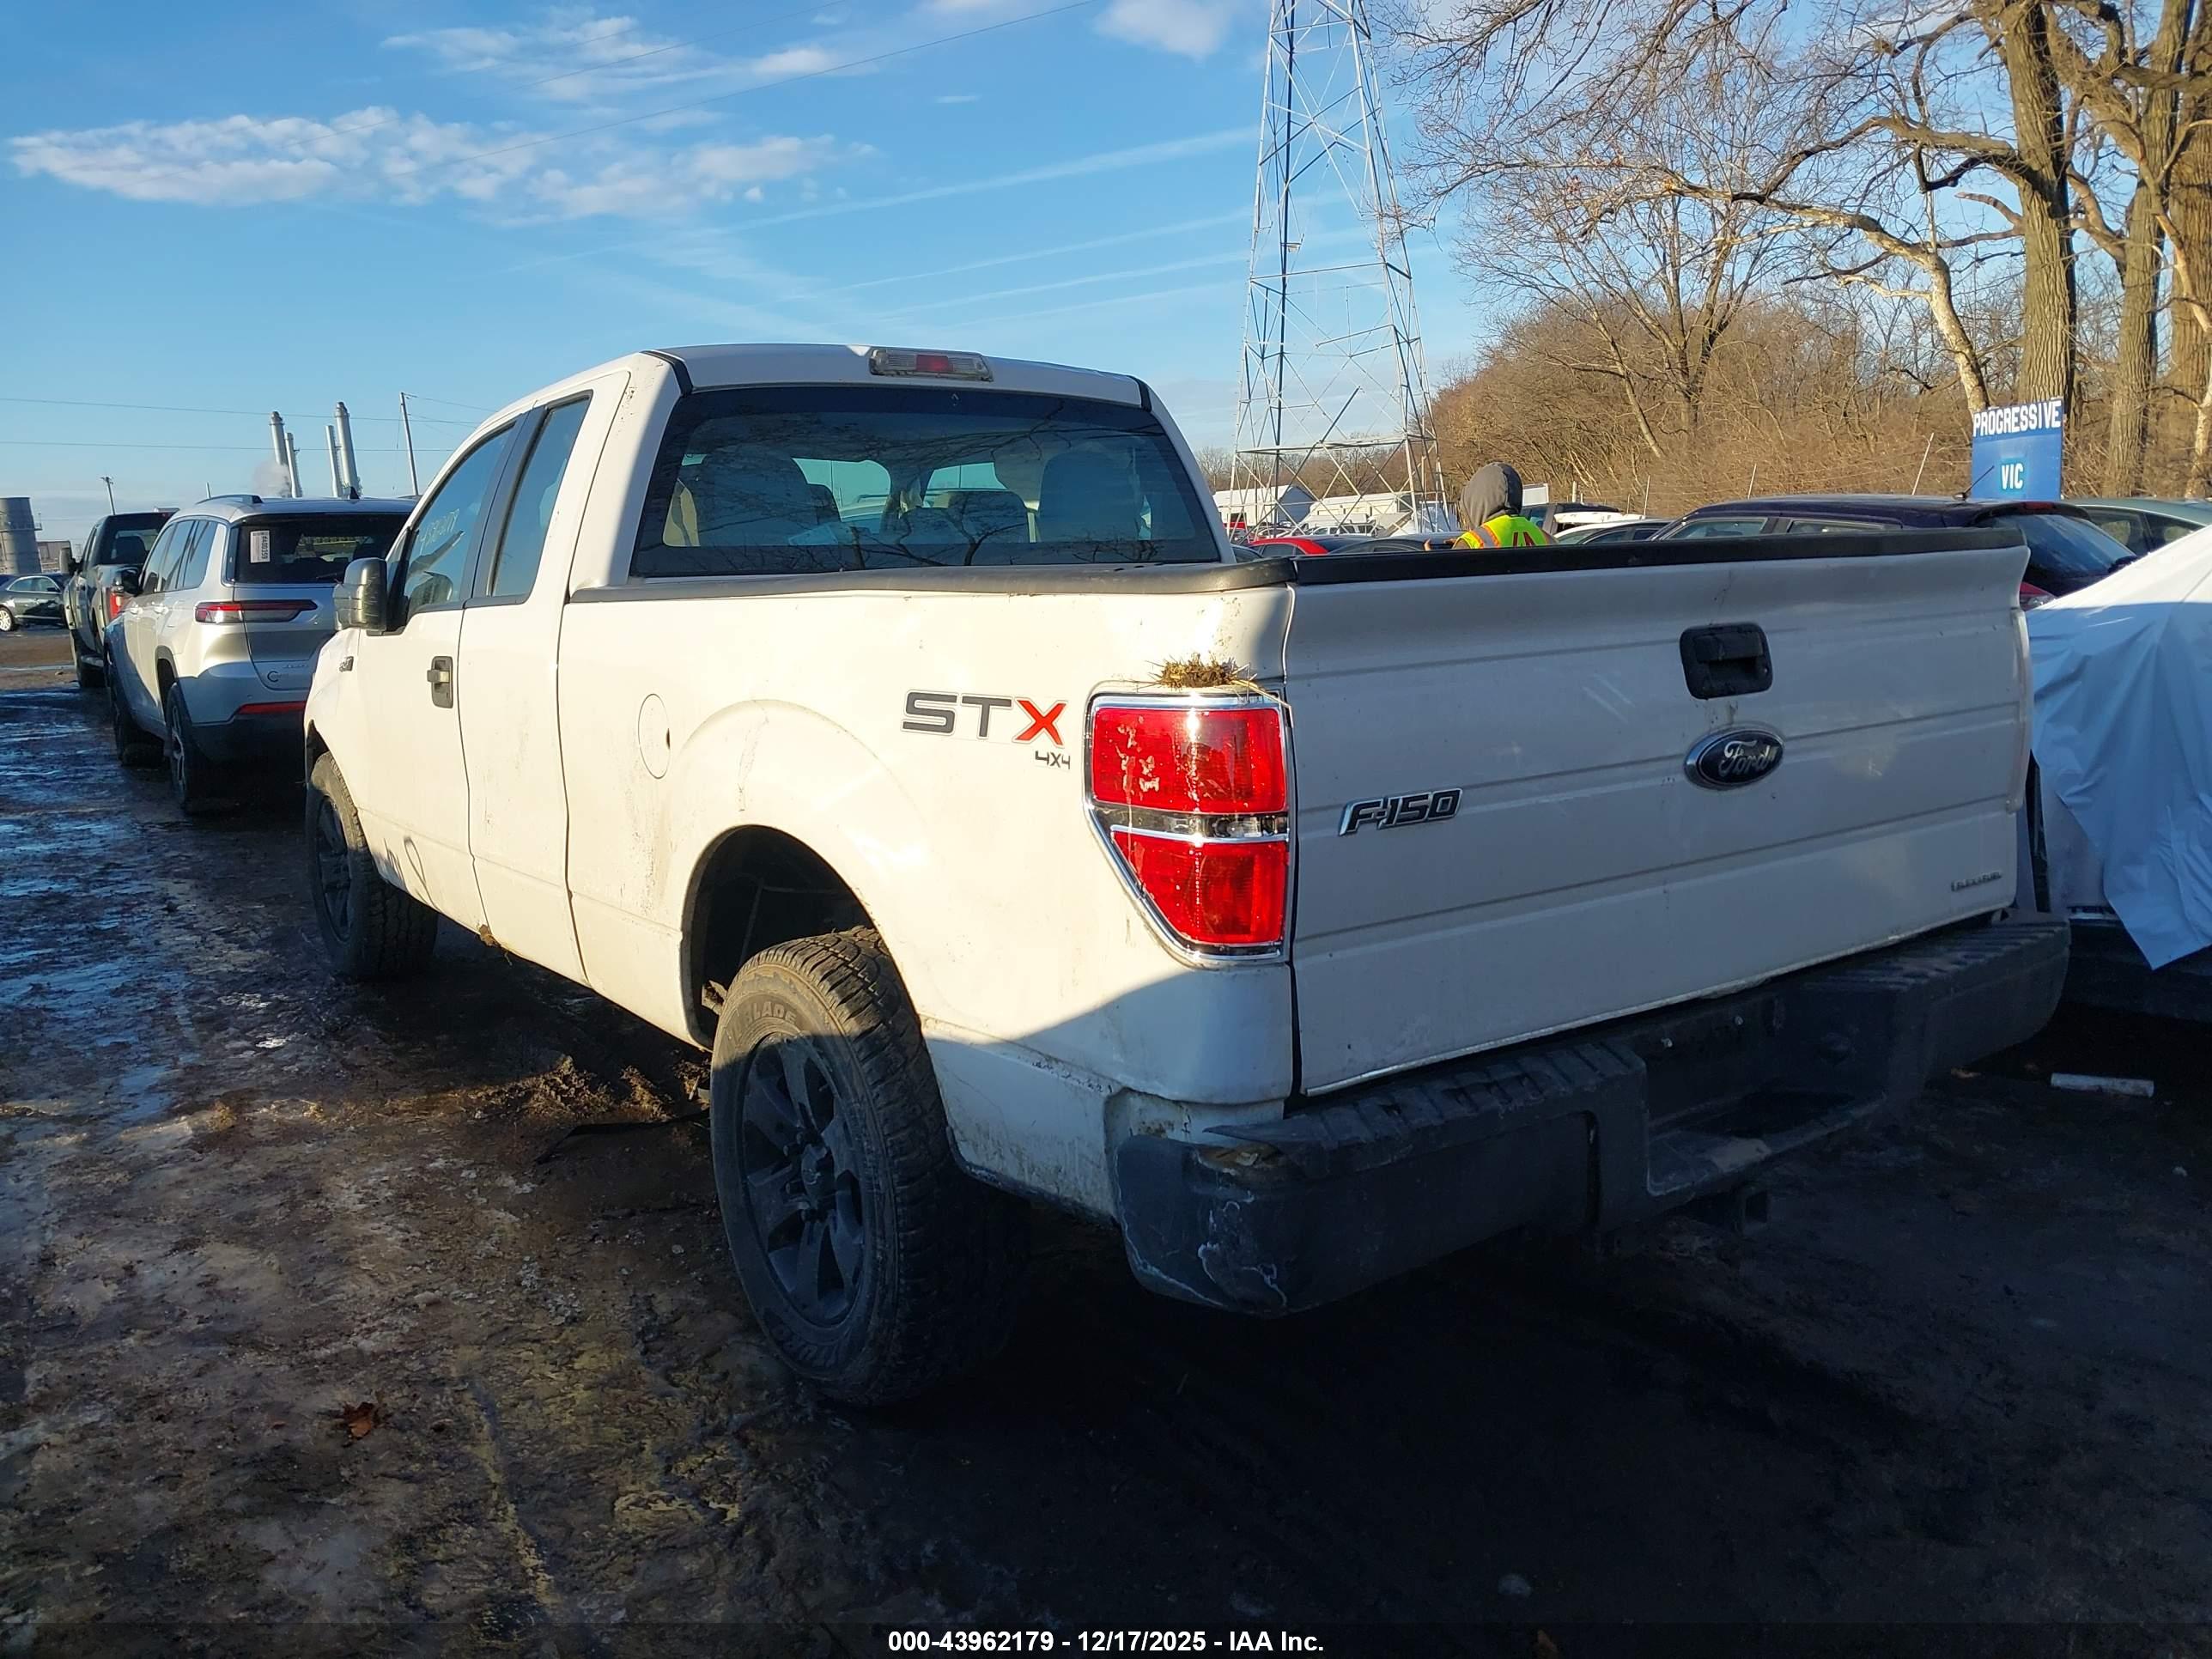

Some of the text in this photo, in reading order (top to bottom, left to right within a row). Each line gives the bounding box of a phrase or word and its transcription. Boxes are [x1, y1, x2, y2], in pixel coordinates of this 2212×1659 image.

[1972, 400, 2062, 436] PROGRESSIVE
[2002, 463, 2024, 489] VIC
[902, 690, 1068, 748] STX
[1718, 739, 1779, 776] Ford
[1339, 787, 1463, 836] F-150
